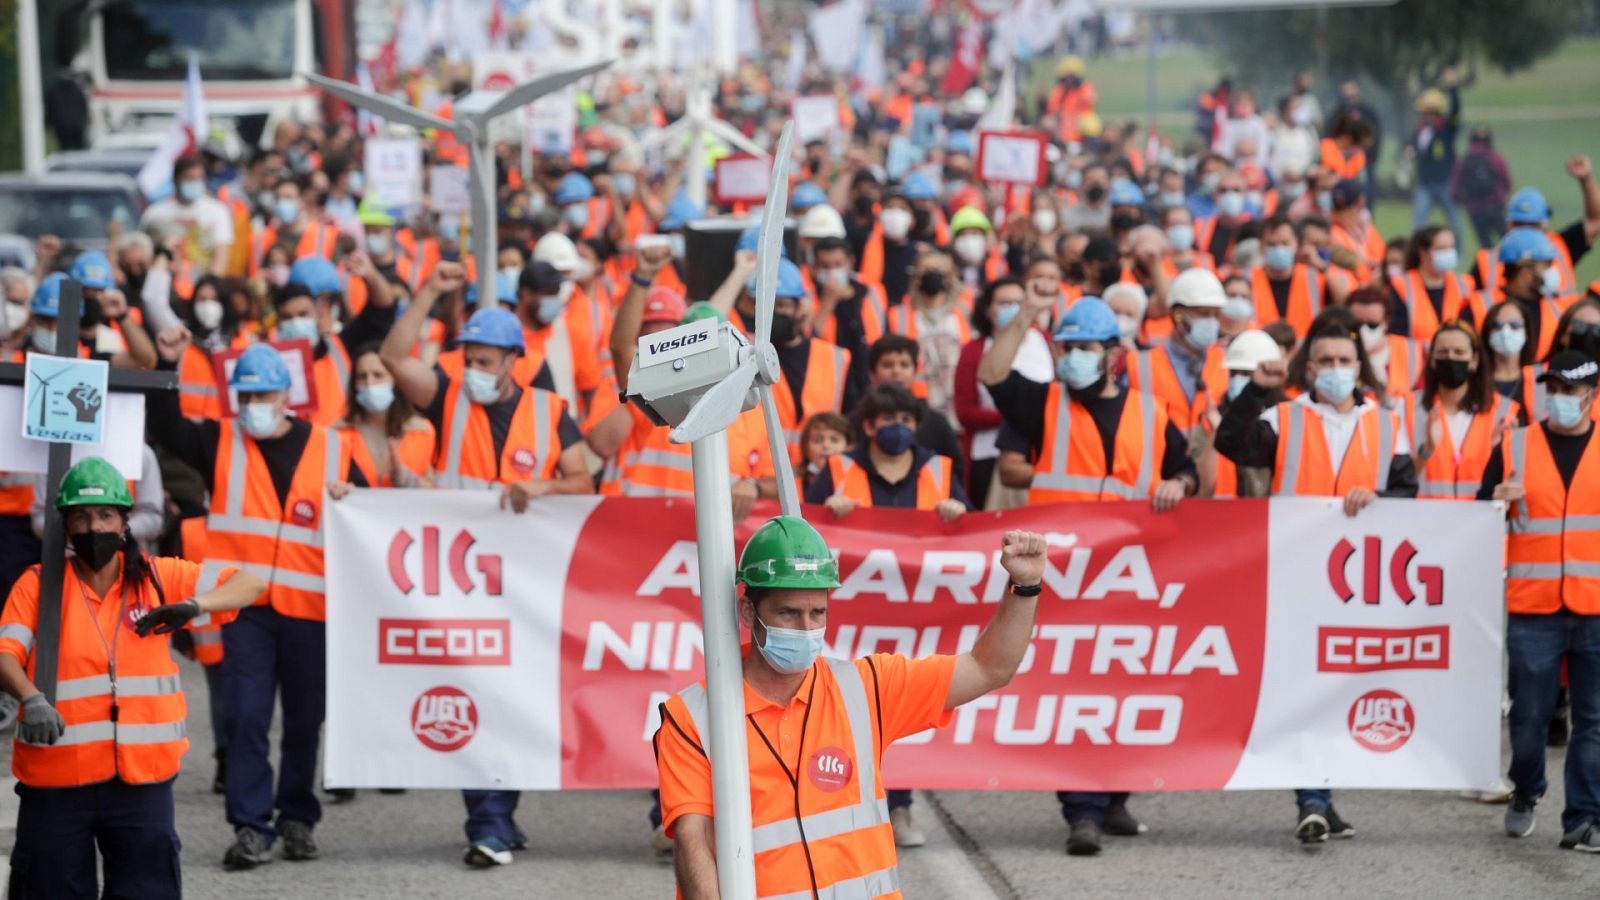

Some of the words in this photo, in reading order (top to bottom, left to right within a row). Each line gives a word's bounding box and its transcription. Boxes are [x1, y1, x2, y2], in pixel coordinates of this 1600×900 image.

[649, 330, 709, 355] Vestas
[27, 424, 93, 441] Vestas
[387, 525, 503, 596] CIG
[636, 539, 699, 597] A
[829, 532, 1186, 609] ARIÑA,
[1327, 535, 1443, 606] CIG
[386, 627, 503, 657] CCOO
[822, 623, 1240, 677] DUTRIA
[1325, 633, 1442, 666] CCOO
[417, 694, 471, 723] UGT
[885, 693, 1185, 747] TURO
[1354, 698, 1409, 728] UGT
[817, 754, 845, 775] CIG
